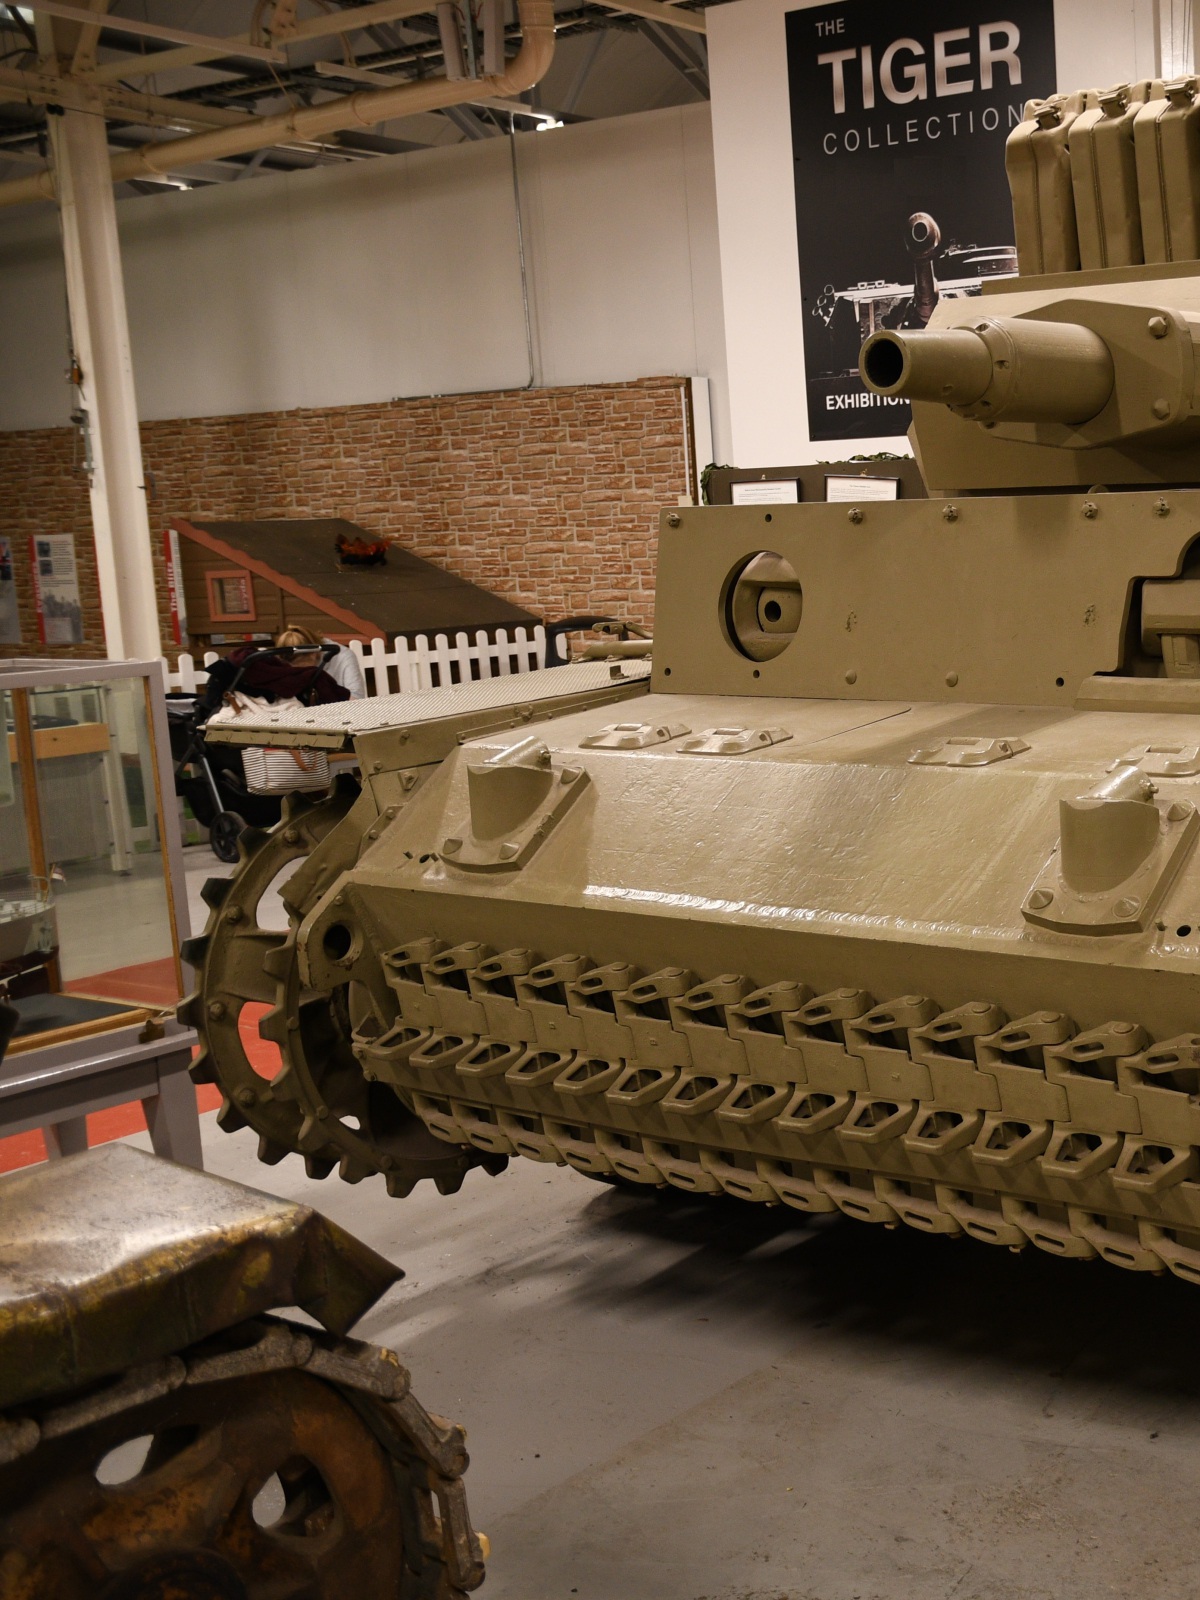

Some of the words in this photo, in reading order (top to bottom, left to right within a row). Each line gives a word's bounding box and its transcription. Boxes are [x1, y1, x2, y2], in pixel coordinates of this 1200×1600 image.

[815, 18, 845, 37] THE
[817, 20, 1022, 114] TIGER
[823, 103, 1024, 155] COLLECTION
[166, 562, 176, 588] Blitz
[169, 591, 179, 612] The
